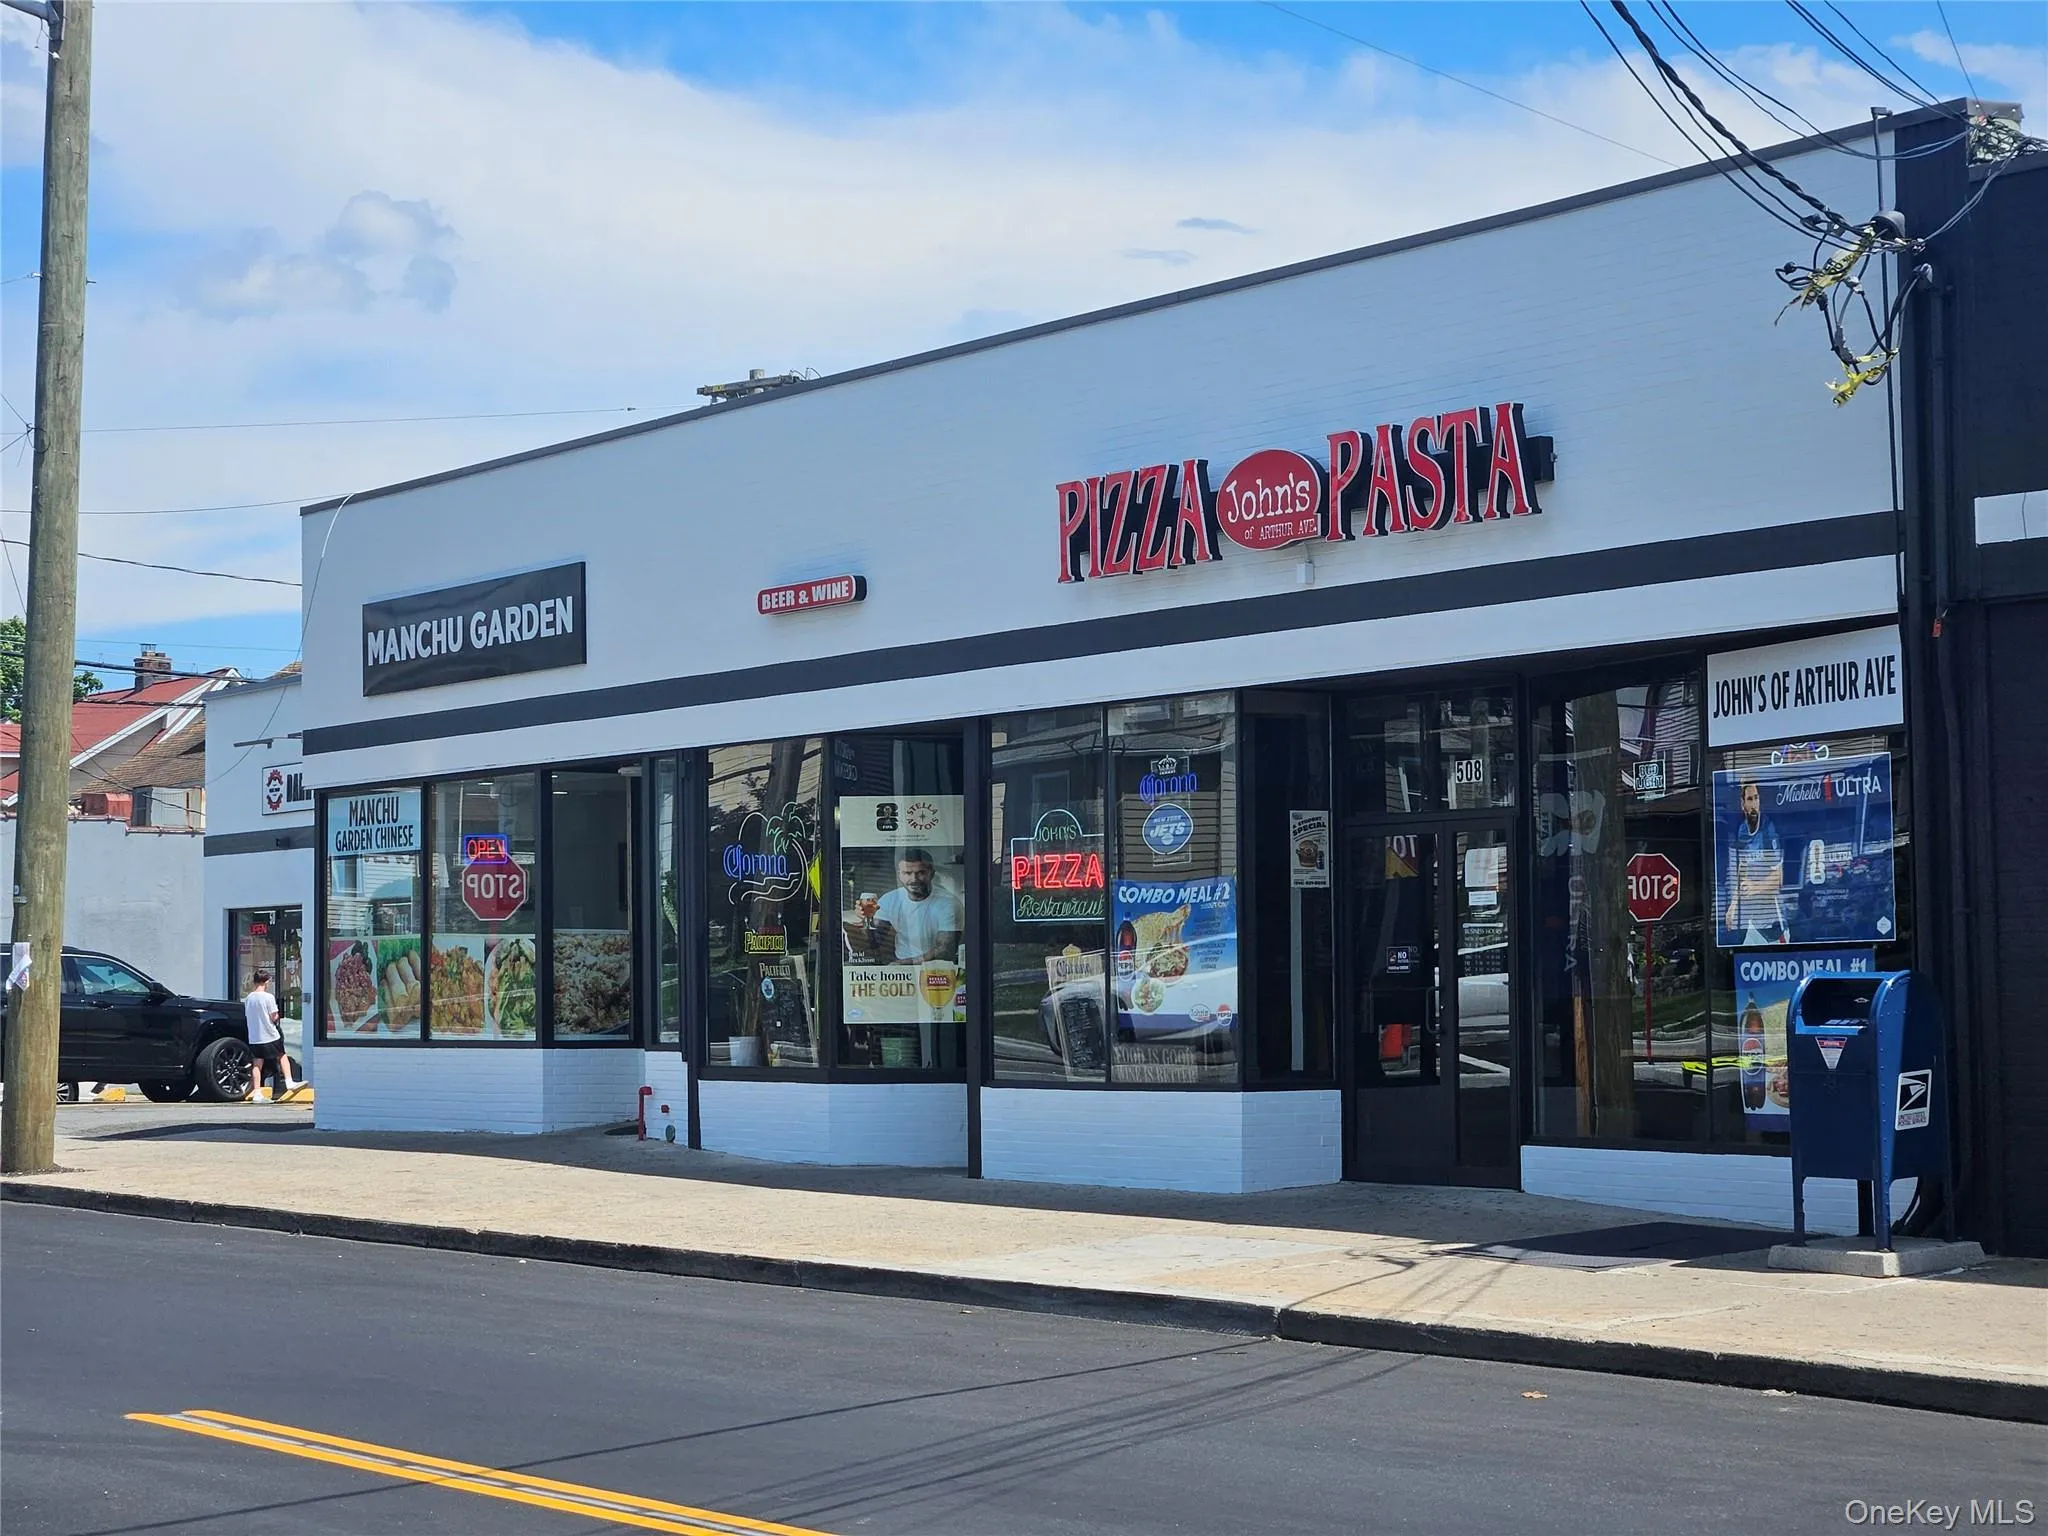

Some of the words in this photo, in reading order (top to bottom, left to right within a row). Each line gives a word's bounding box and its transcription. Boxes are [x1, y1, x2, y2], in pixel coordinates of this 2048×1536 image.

[1055, 458, 1217, 583] PIZZA
[1325, 401, 1535, 543] PASTA
[1226, 472, 1310, 523] John's
[1244, 526, 1255, 540] of
[1260, 522, 1294, 540] ARTHUR
[762, 590, 795, 610] BEER
[798, 590, 809, 604] &
[812, 580, 849, 602] WINE
[367, 615, 464, 667] MANCHU
[470, 596, 573, 649] GARDEN
[1713, 674, 1767, 718] JOHN'S
[1771, 671, 1790, 711] OF
[1794, 661, 1860, 707] ARTHUR
[1864, 655, 1897, 698] AVE
[1457, 760, 1482, 783] 508
[1638, 764, 1660, 778] BUD
[1140, 773, 1197, 806] Corona
[1636, 776, 1663, 790] LIGHT
[1776, 782, 1822, 806] Michelob
[1835, 775, 1882, 798] ULTRA
[349, 796, 399, 827] MANCHU
[906, 802, 939, 816] STELLA
[906, 816, 940, 831] ARTOIS
[1036, 824, 1077, 842] JOHN'S
[1149, 822, 1186, 838] JETS
[1292, 821, 1327, 837] SPECIAL
[335, 828, 373, 852] GARDEN
[375, 825, 414, 849] CHINESE
[467, 839, 506, 859] OPEN
[723, 844, 788, 880] Corona
[1012, 853, 1104, 889] PIZZA
[1118, 886, 1175, 904] COMBO
[1176, 884, 1212, 904] MEAL
[1213, 882, 1231, 901] #2
[744, 931, 785, 952] PACIFICO
[1397, 951, 1407, 959] NO
[759, 962, 791, 978] PACIFICO
[849, 971, 878, 981] Take
[880, 971, 912, 981] home
[1740, 960, 1800, 982] COMBO
[850, 983, 876, 998] THE
[880, 982, 916, 998] GOLD
